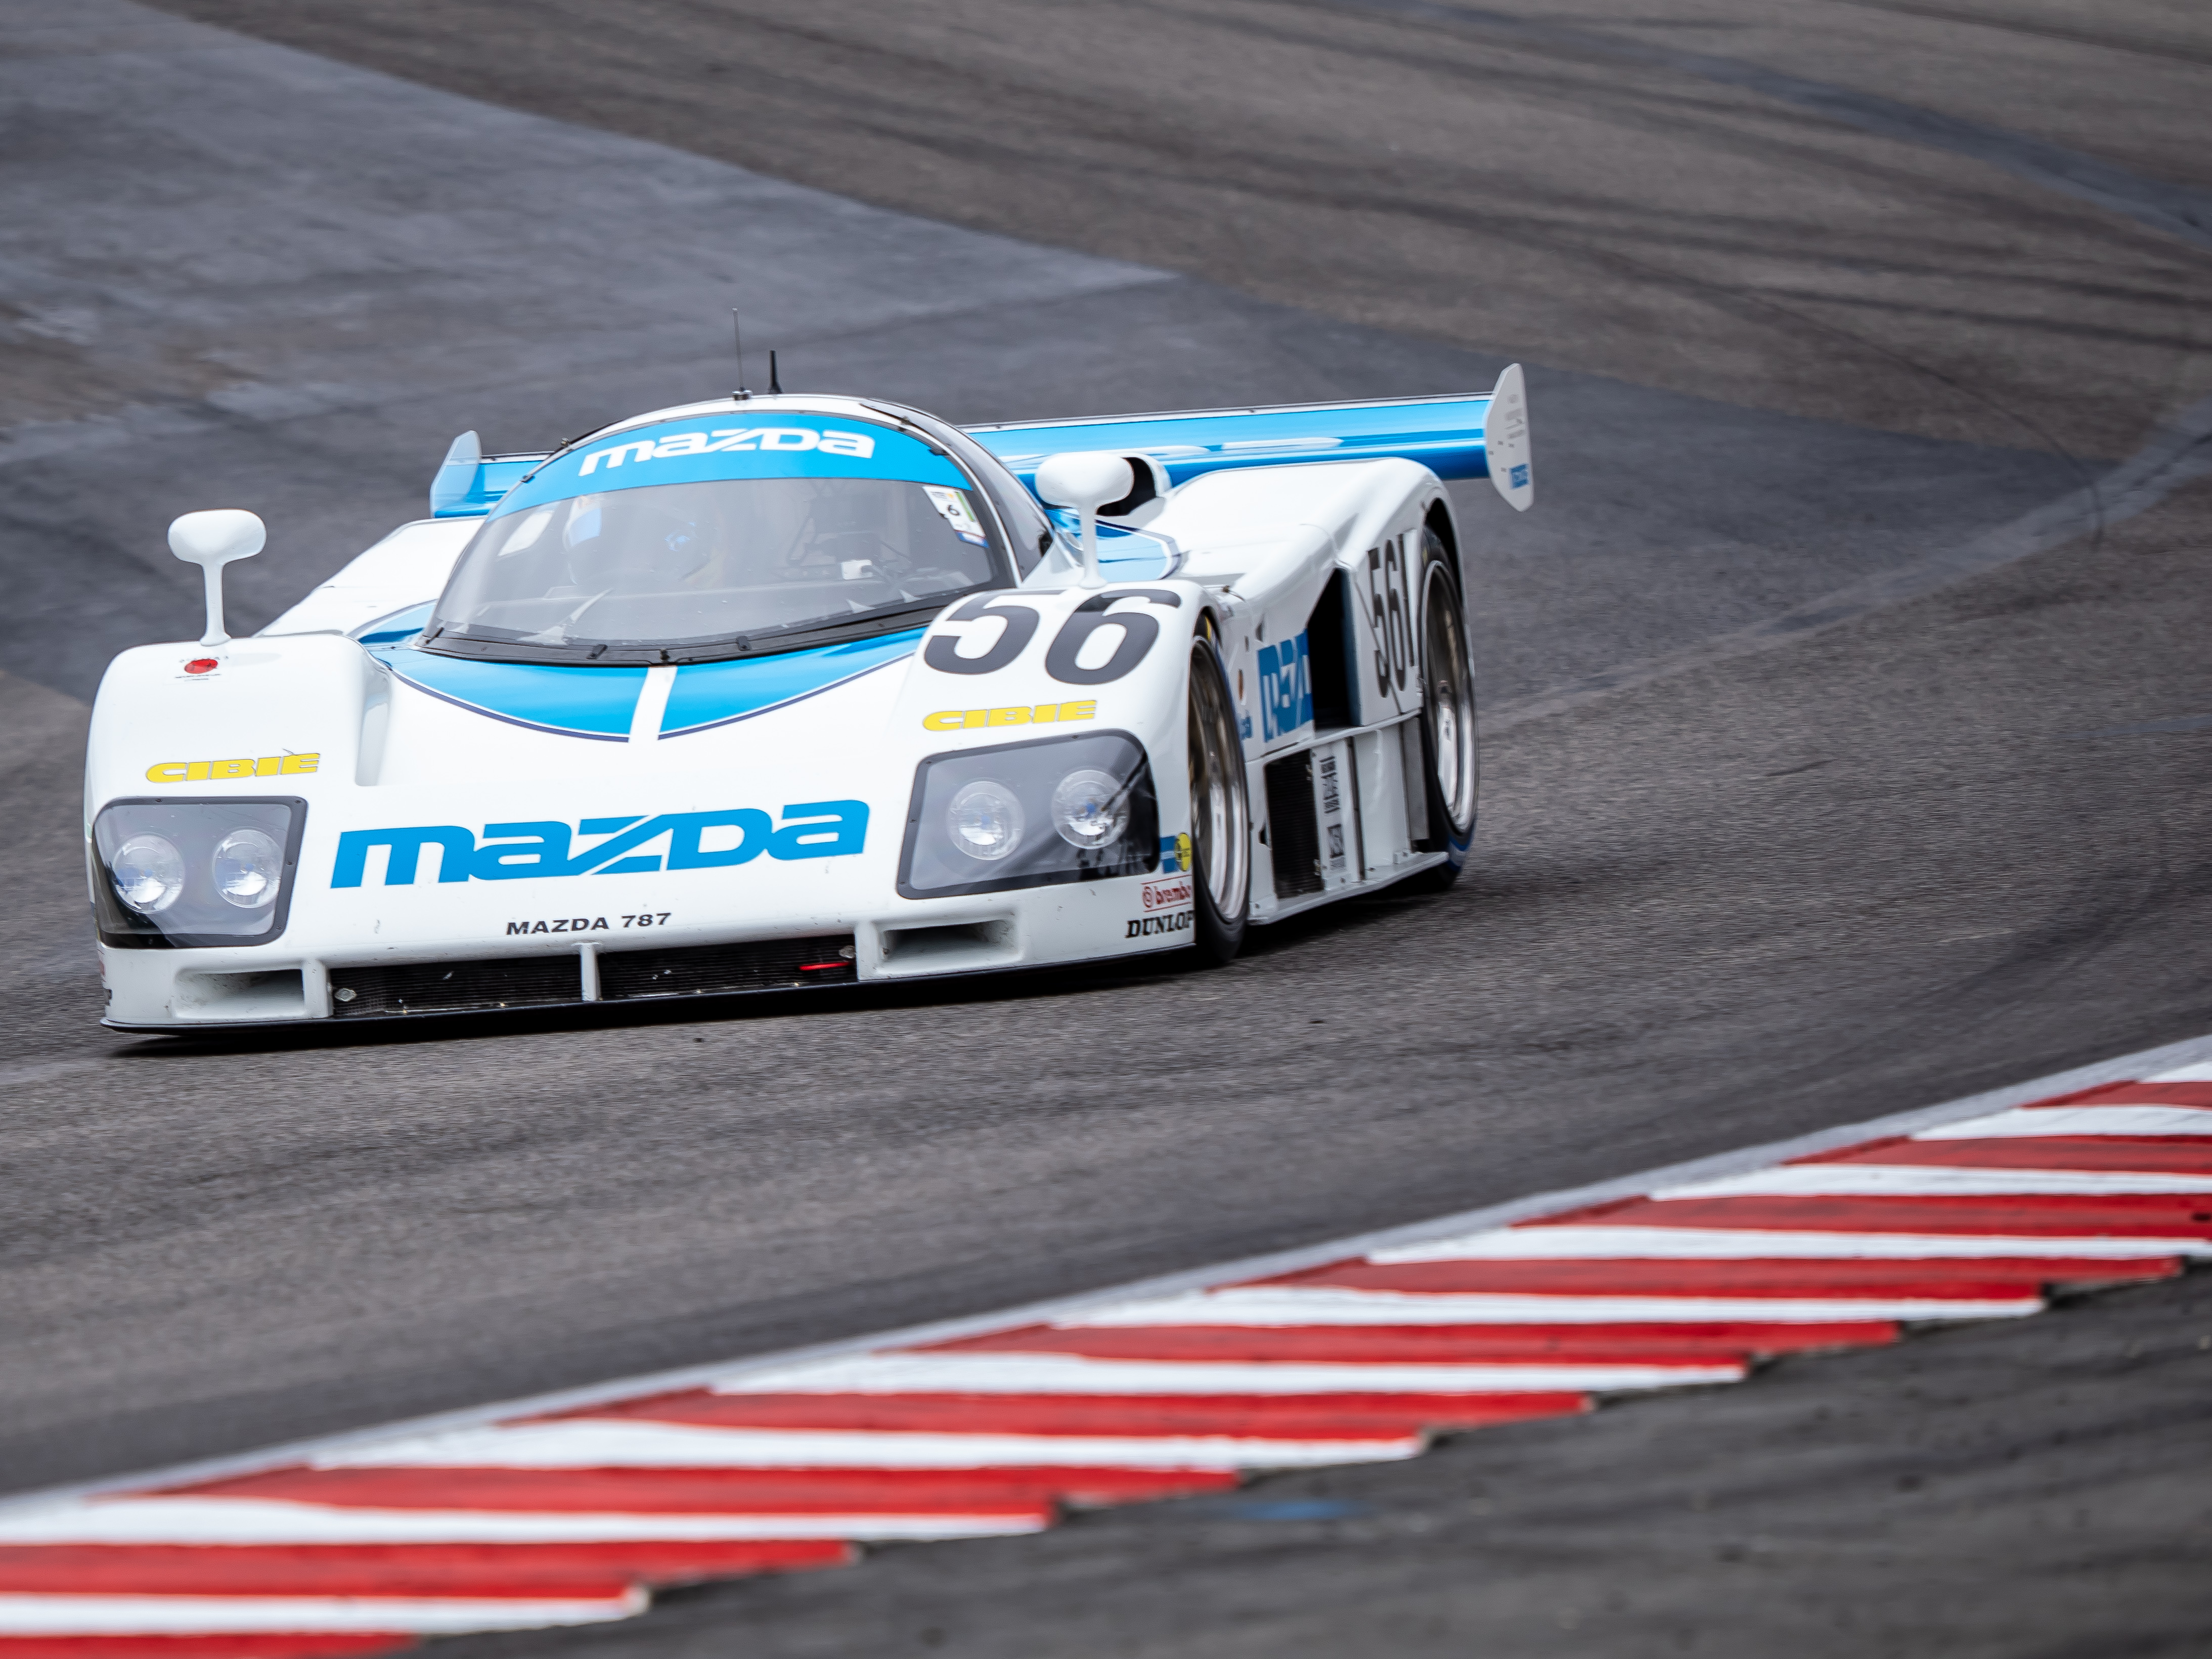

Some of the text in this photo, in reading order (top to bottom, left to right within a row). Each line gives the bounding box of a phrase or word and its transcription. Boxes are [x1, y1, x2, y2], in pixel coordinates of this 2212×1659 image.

[923, 589, 1181, 685] 56
[922, 699, 1097, 731] CIBIE
[506, 912, 672, 935] MAZDA 787
